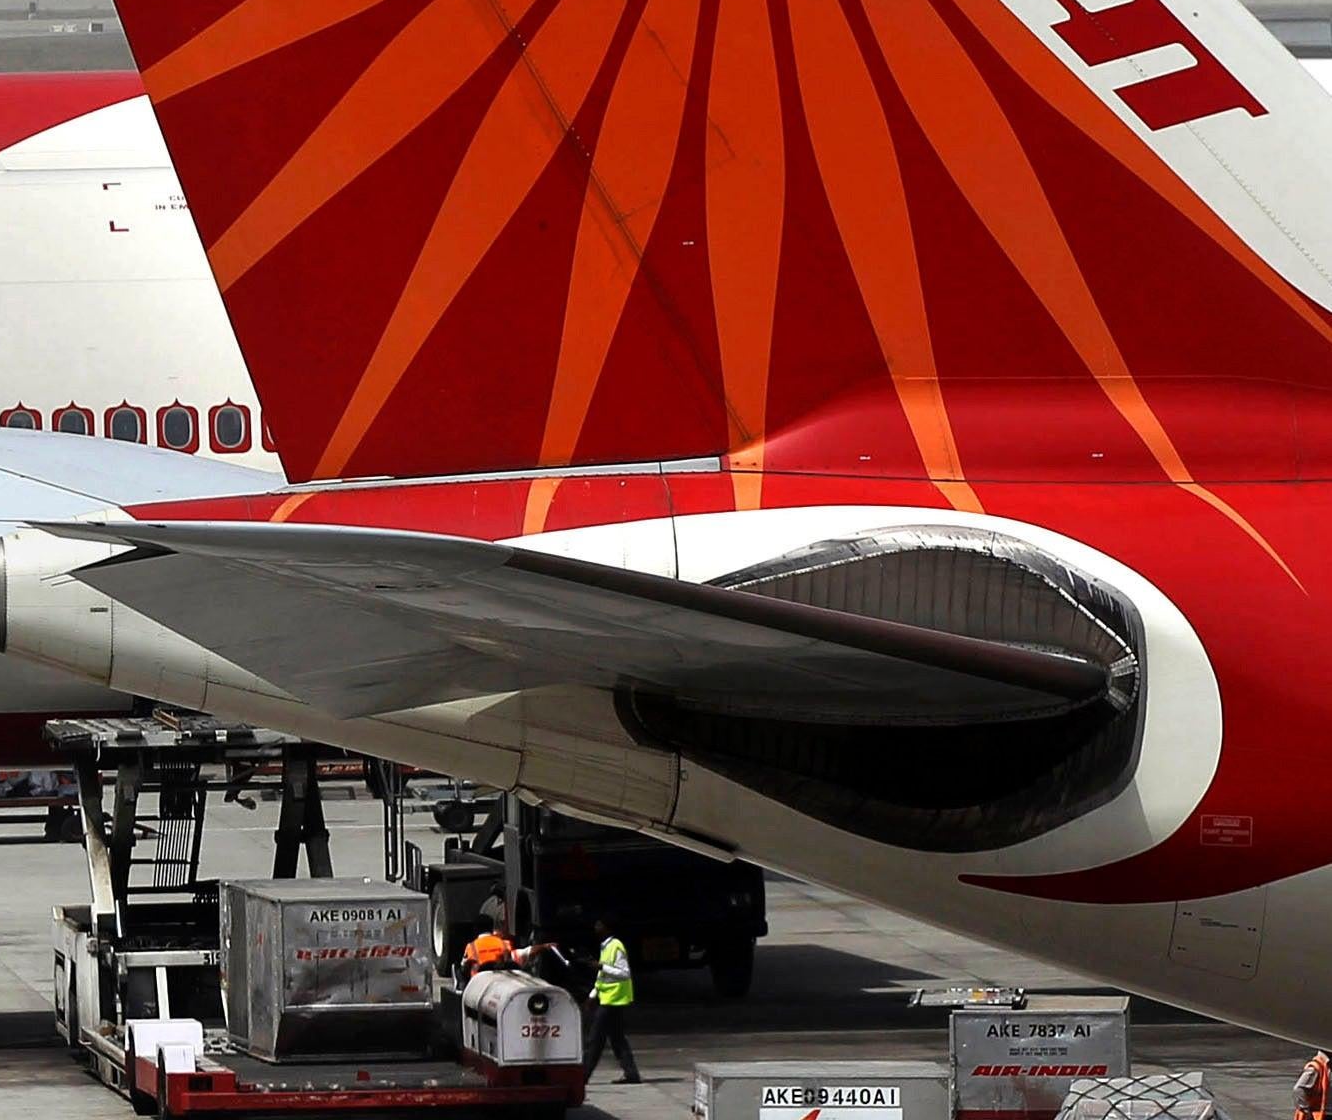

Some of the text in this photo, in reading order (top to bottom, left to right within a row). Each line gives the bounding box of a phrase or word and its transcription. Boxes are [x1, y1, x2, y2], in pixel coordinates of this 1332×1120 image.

[309, 908, 402, 923] AKE 09081 AI
[521, 1025, 561, 1038] 3272
[986, 1024, 1091, 1038] AKE 7837 AI
[972, 1064, 1109, 1077] AIR-INDIA
